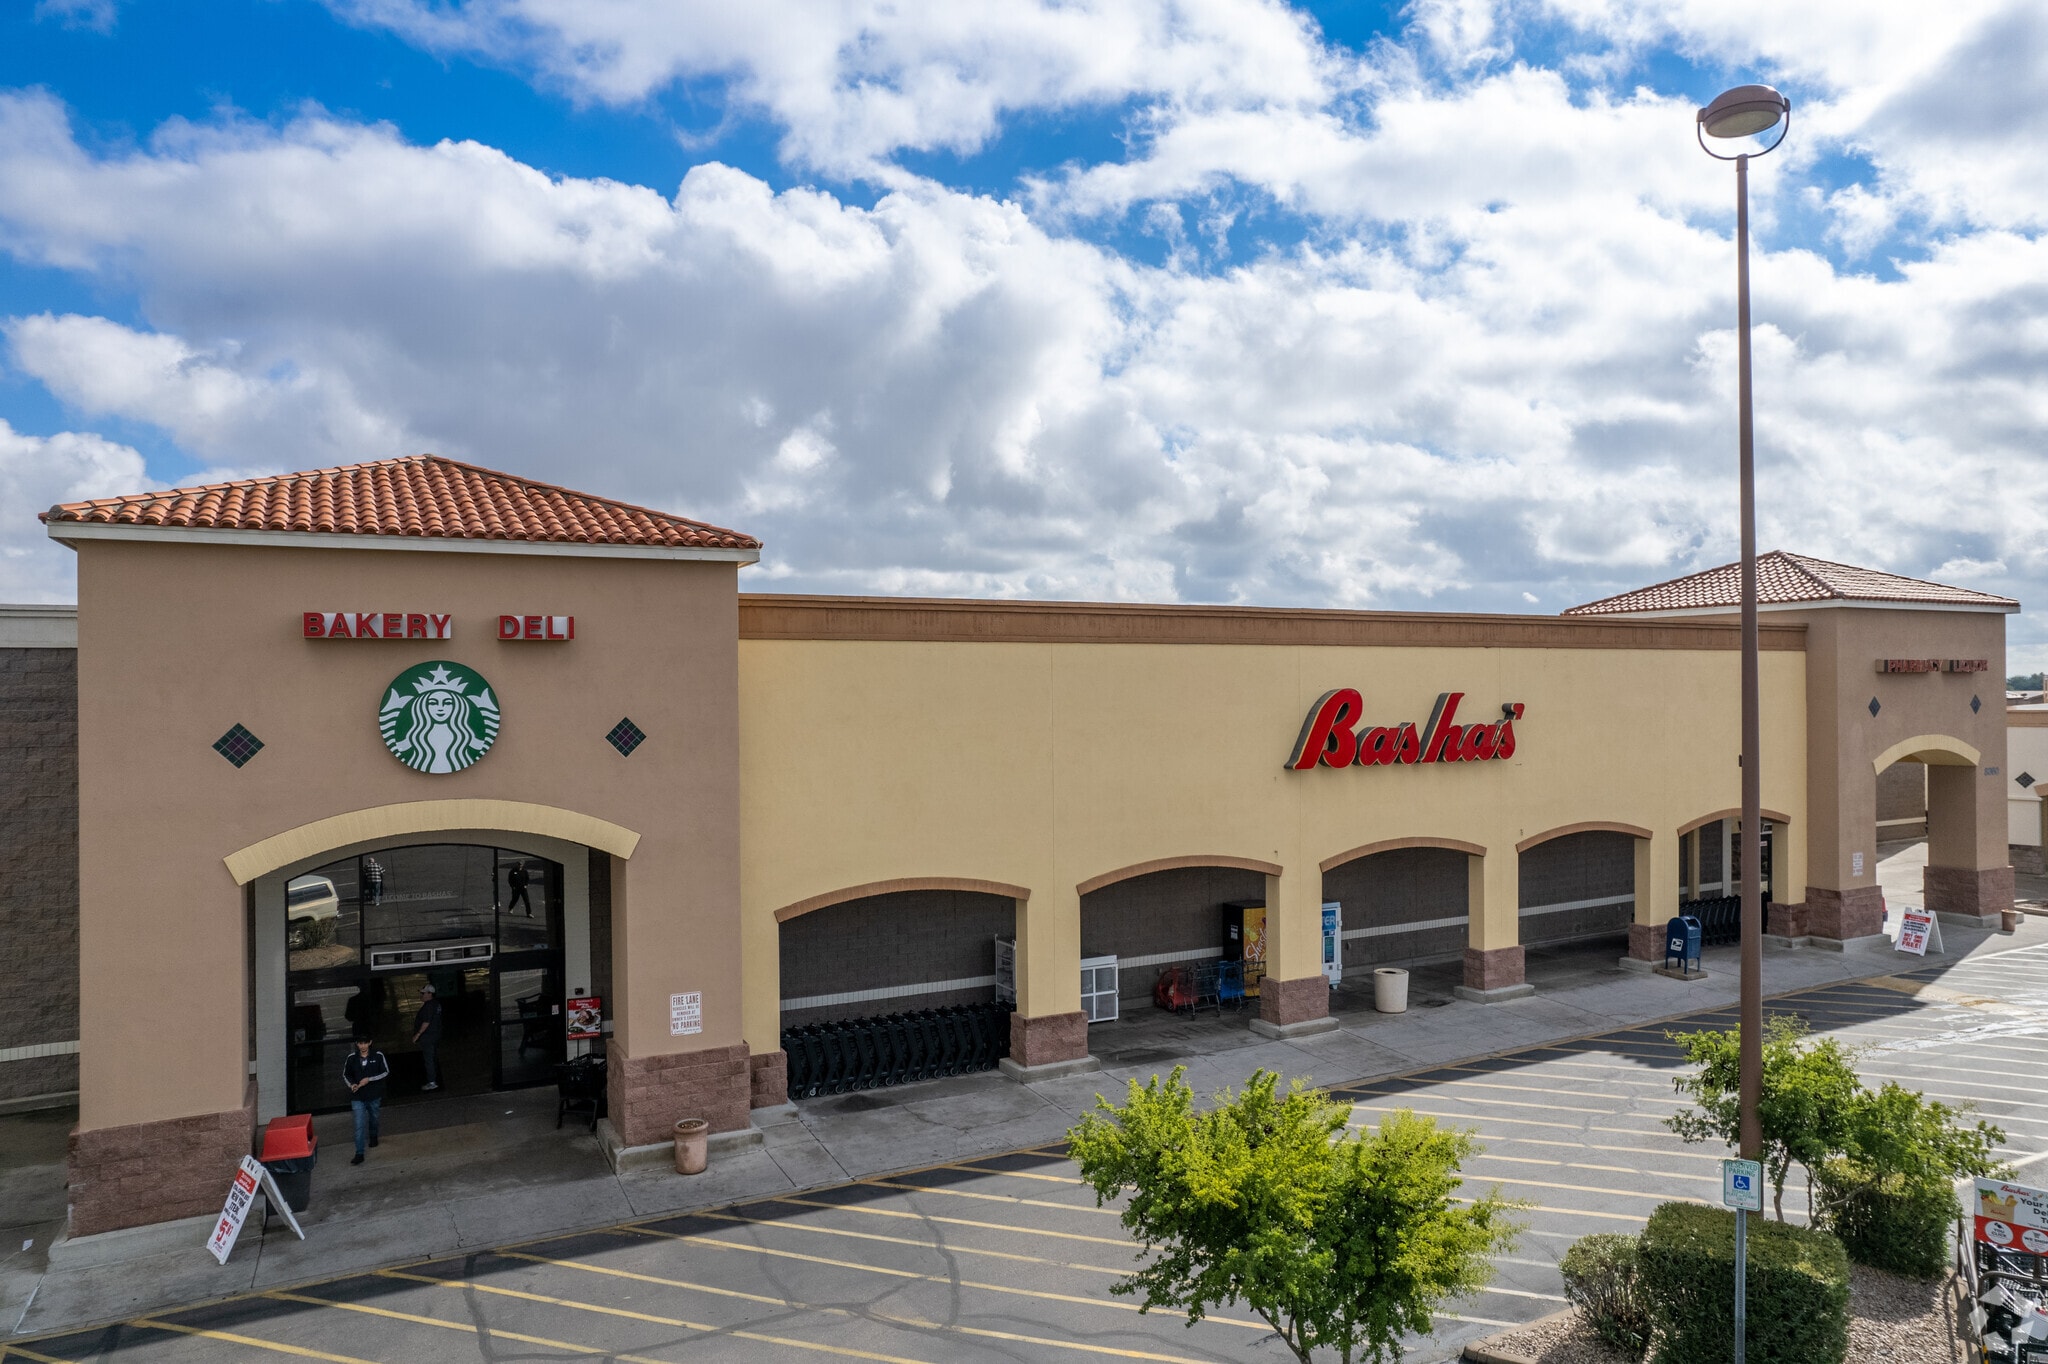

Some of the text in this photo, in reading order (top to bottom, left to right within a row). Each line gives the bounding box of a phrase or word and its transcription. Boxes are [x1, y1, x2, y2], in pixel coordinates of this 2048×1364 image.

[303, 612, 452, 639] BAKERY
[497, 615, 575, 640] DELI
[1884, 659, 1943, 673] PHARMACY
[673, 995, 699, 1006] FIRE LANE
[673, 1020, 700, 1030] NO PARKING
[1726, 1161, 1758, 1171] RESERVED
[1728, 1167, 1755, 1177] PARKING
[2020, 1197, 2044, 1208] Your
